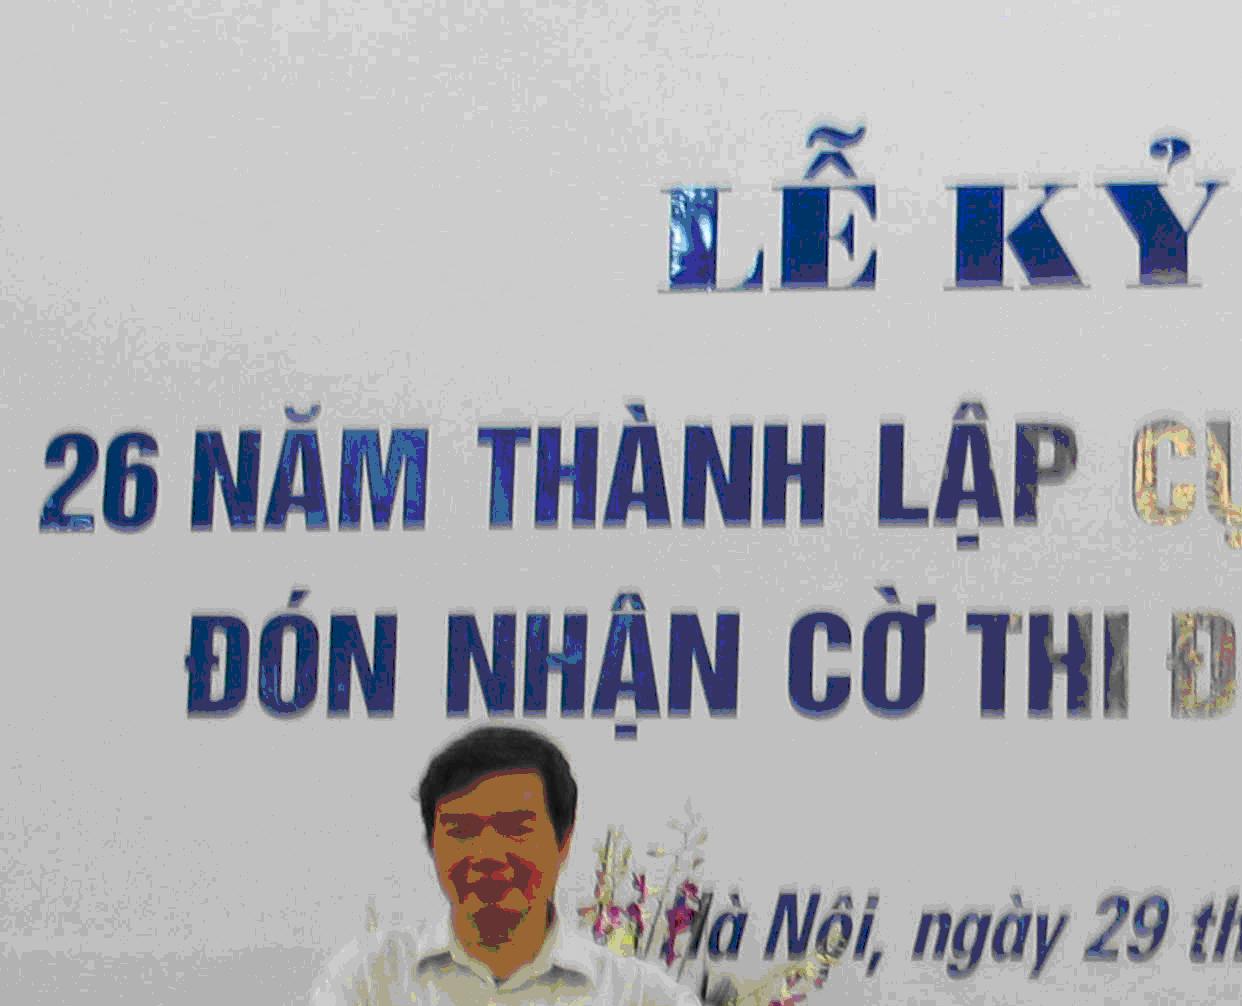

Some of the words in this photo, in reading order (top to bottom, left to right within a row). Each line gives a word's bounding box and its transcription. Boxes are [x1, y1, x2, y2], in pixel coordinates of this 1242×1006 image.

[658, 123, 878, 292] LỄ
[944, 137, 1229, 289] KỶ
[39, 431, 160, 533] 26
[190, 403, 430, 533] NĂM
[478, 402, 827, 530] THÀNH
[878, 401, 1078, 551] LẬP
[185, 589, 398, 719] ĐÓN
[446, 592, 741, 740] NHẬN
[788, 586, 937, 717] CỜ
[966, 606, 1130, 719] THI
[763, 892, 882, 987] Nội,
[912, 894, 1068, 978] ngày
[1085, 893, 1170, 963] 29
